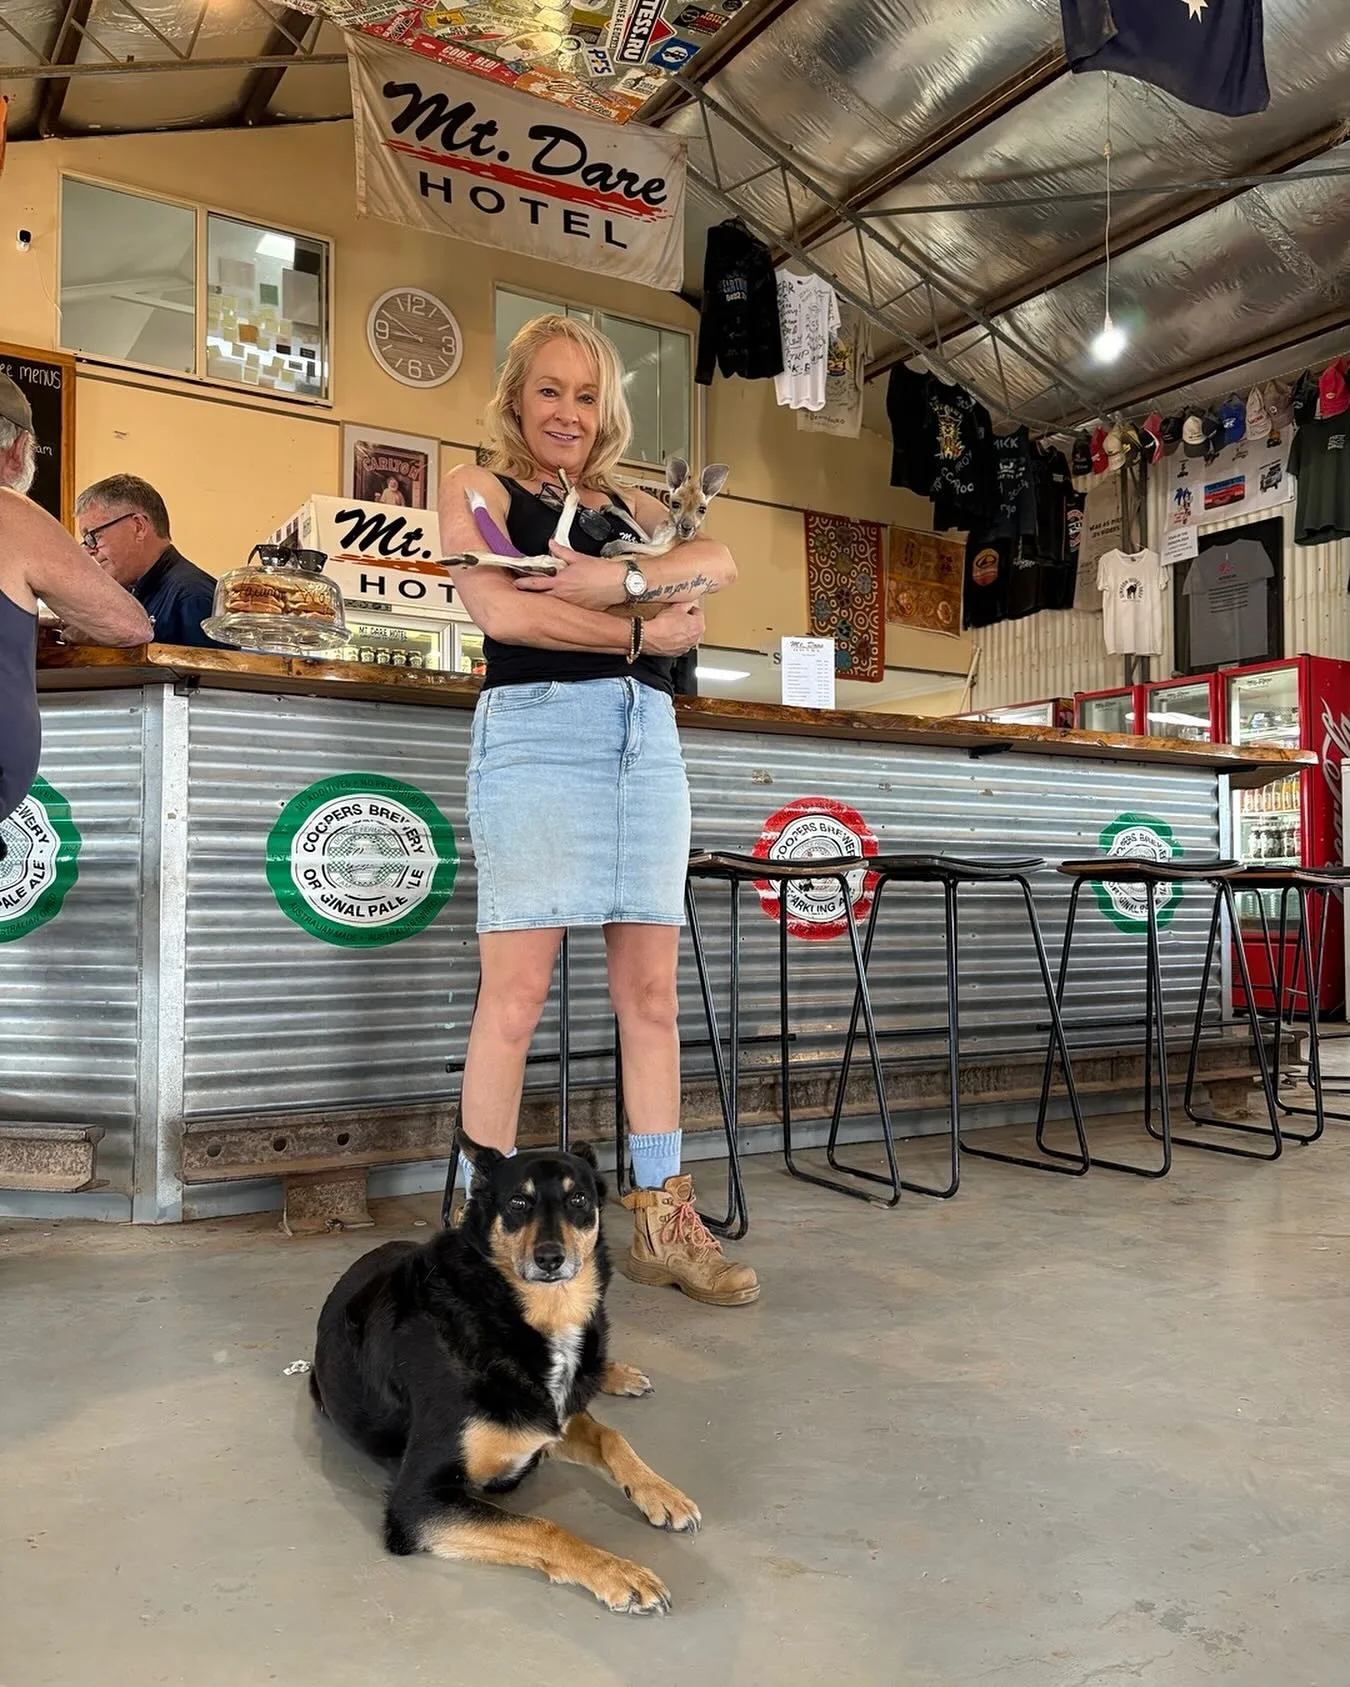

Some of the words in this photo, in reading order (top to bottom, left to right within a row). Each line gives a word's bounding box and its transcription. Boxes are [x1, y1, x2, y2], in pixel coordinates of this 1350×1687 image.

[442, 45, 472, 61] CODE
[473, 57, 500, 72] RED!
[383, 80, 510, 163] Mt.
[528, 125, 667, 205] Dare
[419, 171, 628, 249] HOTEL
[375, 319, 389, 340] 9
[442, 336, 455, 355] 3
[20, 366, 61, 390] menus
[408, 359, 422, 378] 6
[362, 456, 421, 480] CARLTON
[334, 508, 432, 559] Mt.
[303, 803, 363, 853] COOPERS
[369, 804, 426, 854] BREWERY
[0, 886, 28, 910] ALE
[28, 859, 46, 889] ALE
[368, 895, 409, 917] PALE
[787, 886, 836, 911] ARKLING
